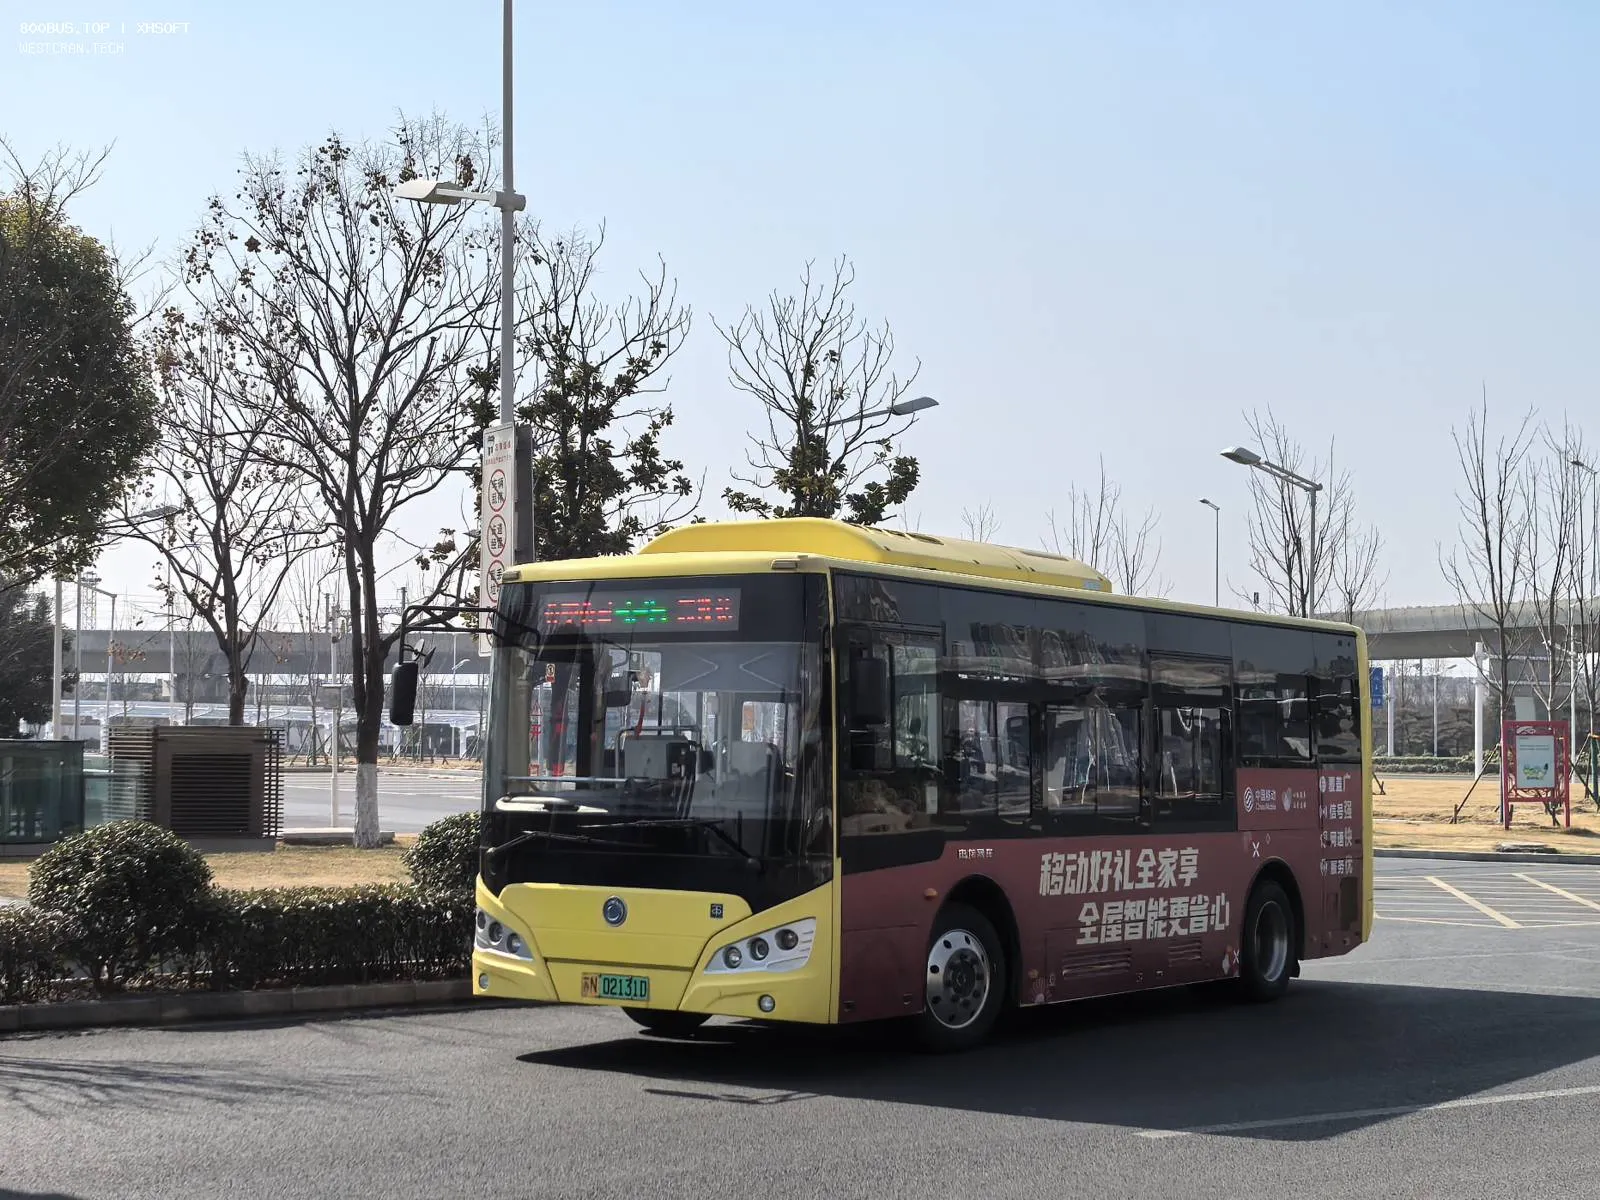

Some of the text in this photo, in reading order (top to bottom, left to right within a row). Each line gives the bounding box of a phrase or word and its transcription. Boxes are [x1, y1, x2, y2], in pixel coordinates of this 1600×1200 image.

[1330, 800, 1352, 820] 信号强
[1039, 847, 1199, 896] 移动好礼全家享
[1076, 892, 1230, 945] 全屋智能更省心
